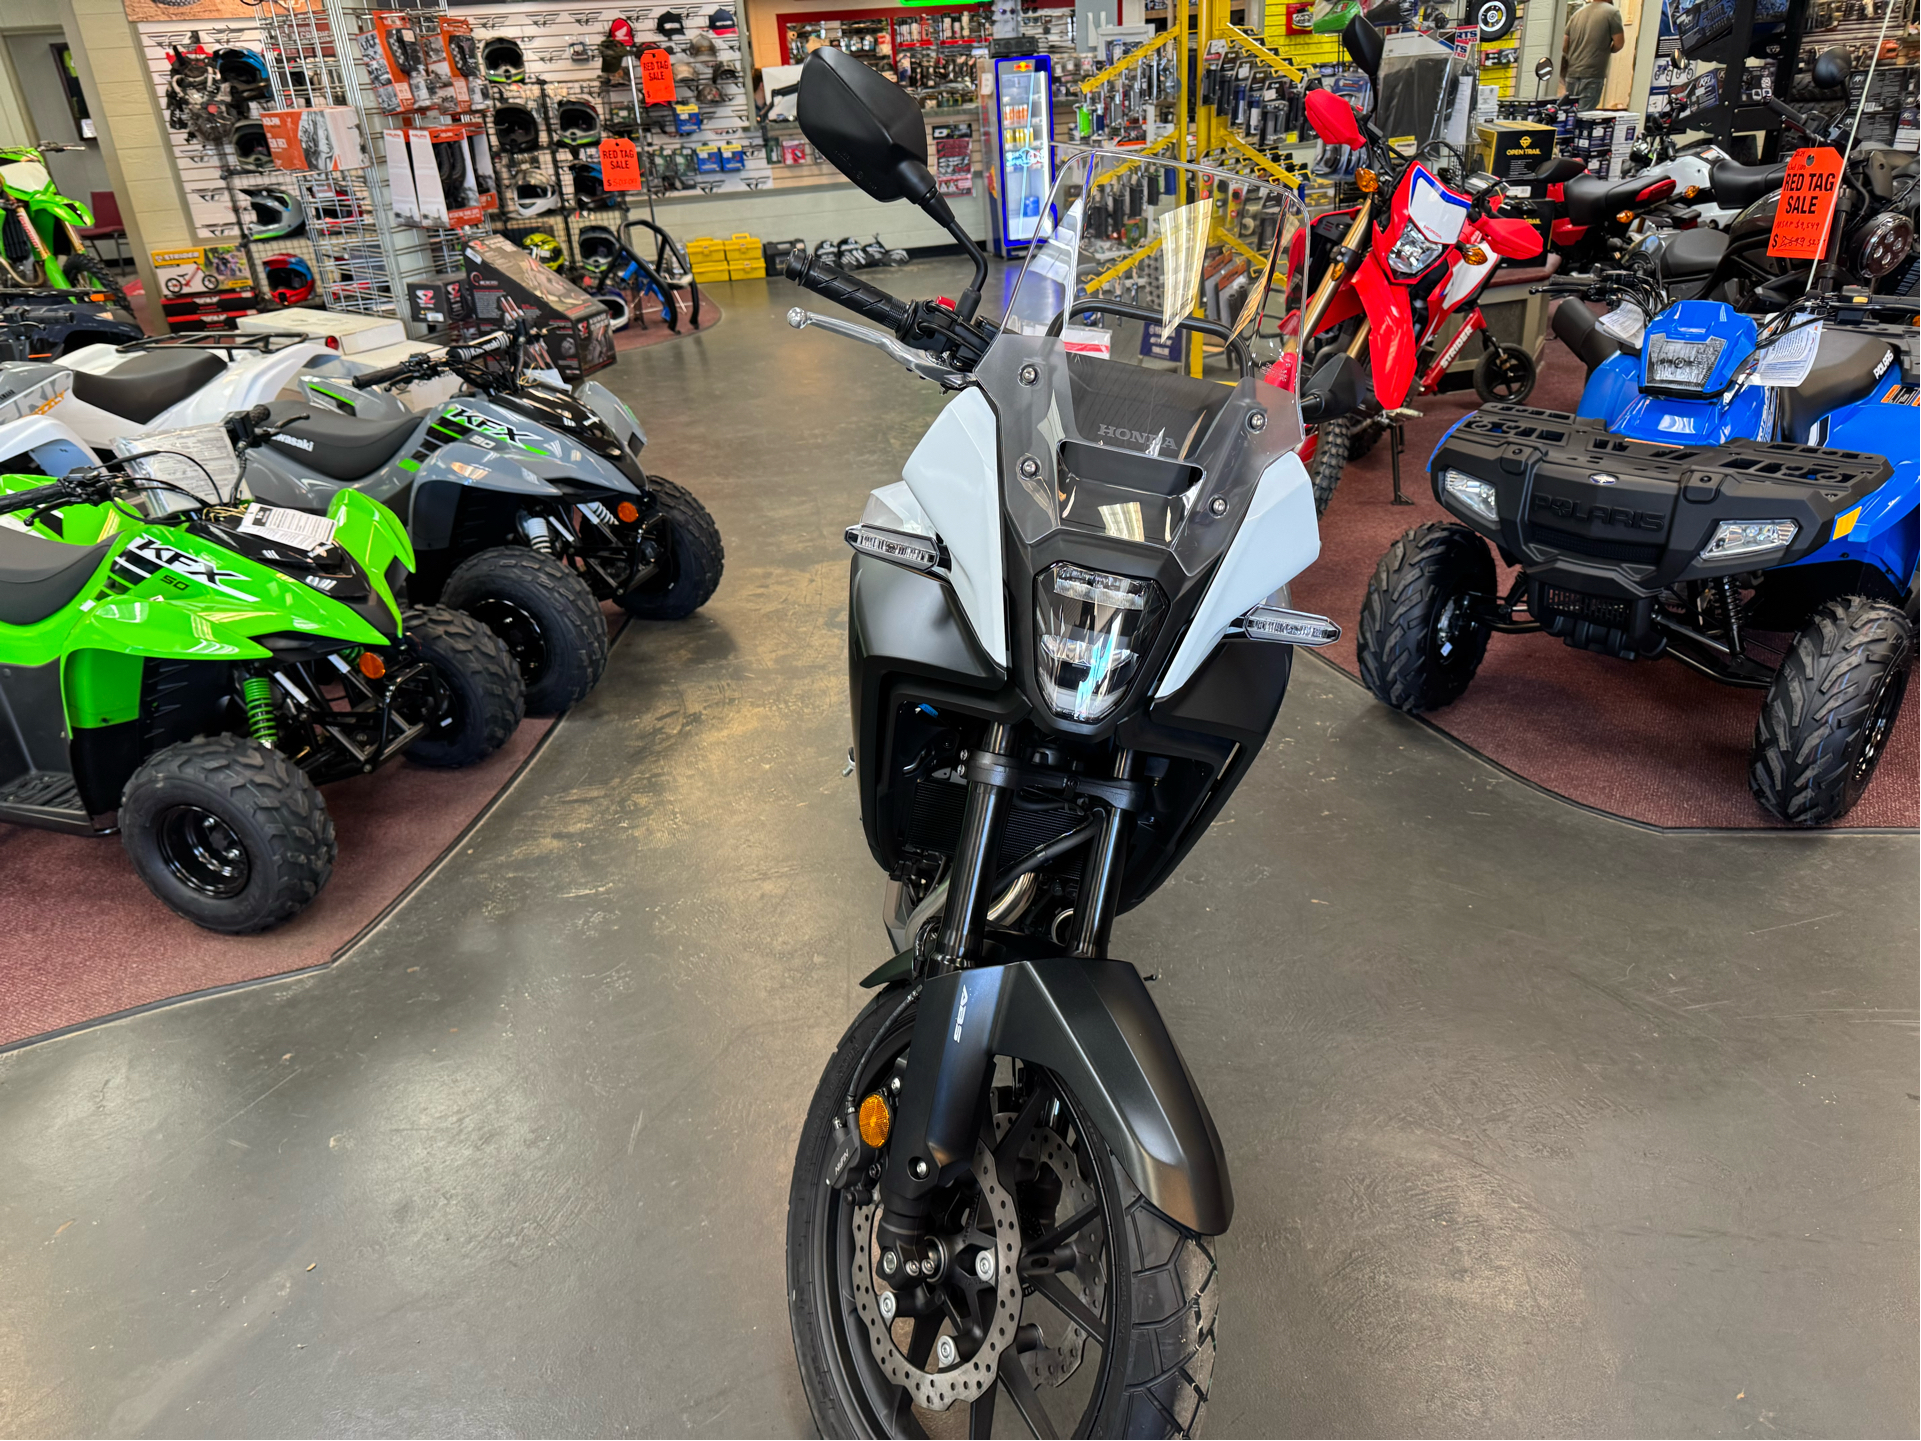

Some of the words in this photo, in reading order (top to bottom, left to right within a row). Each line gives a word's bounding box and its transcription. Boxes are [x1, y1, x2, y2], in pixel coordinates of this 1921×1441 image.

[643, 61, 655, 72] RED
[656, 60, 669, 71] TAG
[648, 72, 665, 82] SALE
[602, 150, 618, 160] RED
[620, 149, 635, 159] TAG
[610, 160, 630, 170] SALE
[1783, 173, 1804, 192] RED
[1808, 173, 1836, 192] TAG
[1785, 195, 1818, 215] SALE
[1423, 224, 1442, 240] HONDA
[1440, 324, 1474, 369] STRIDER
[1873, 349, 1894, 380] POLARIS
[446, 404, 543, 448] KFX
[270, 431, 314, 452] wasaki
[469, 435, 497, 449] 90
[1098, 423, 1178, 450] HONDA
[1533, 492, 1666, 532] POLARIS
[130, 534, 250, 588] KFX
[160, 574, 190, 591] 50
[953, 984, 968, 1043] ABS
